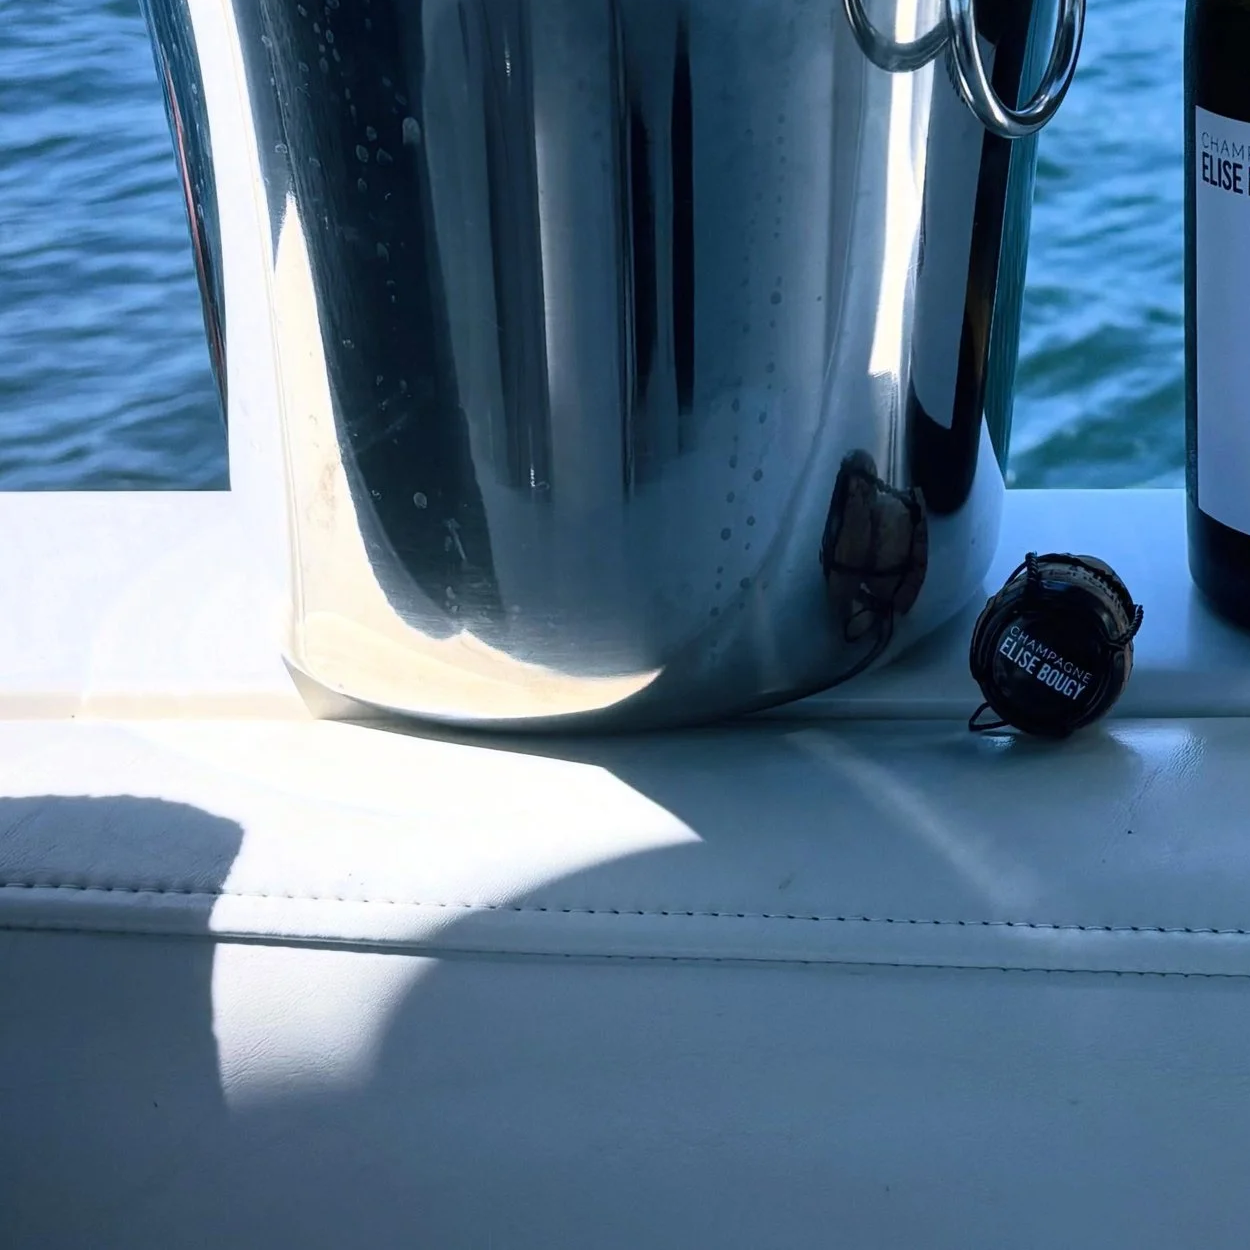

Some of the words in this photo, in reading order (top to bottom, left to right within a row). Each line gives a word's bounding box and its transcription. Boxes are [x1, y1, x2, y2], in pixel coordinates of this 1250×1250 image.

[1202, 151, 1243, 194] ELISE
[999, 637, 1040, 675] ELISE
[1037, 663, 1086, 700] BOUGY
[1010, 626, 1092, 684] CHAMPAGNE
